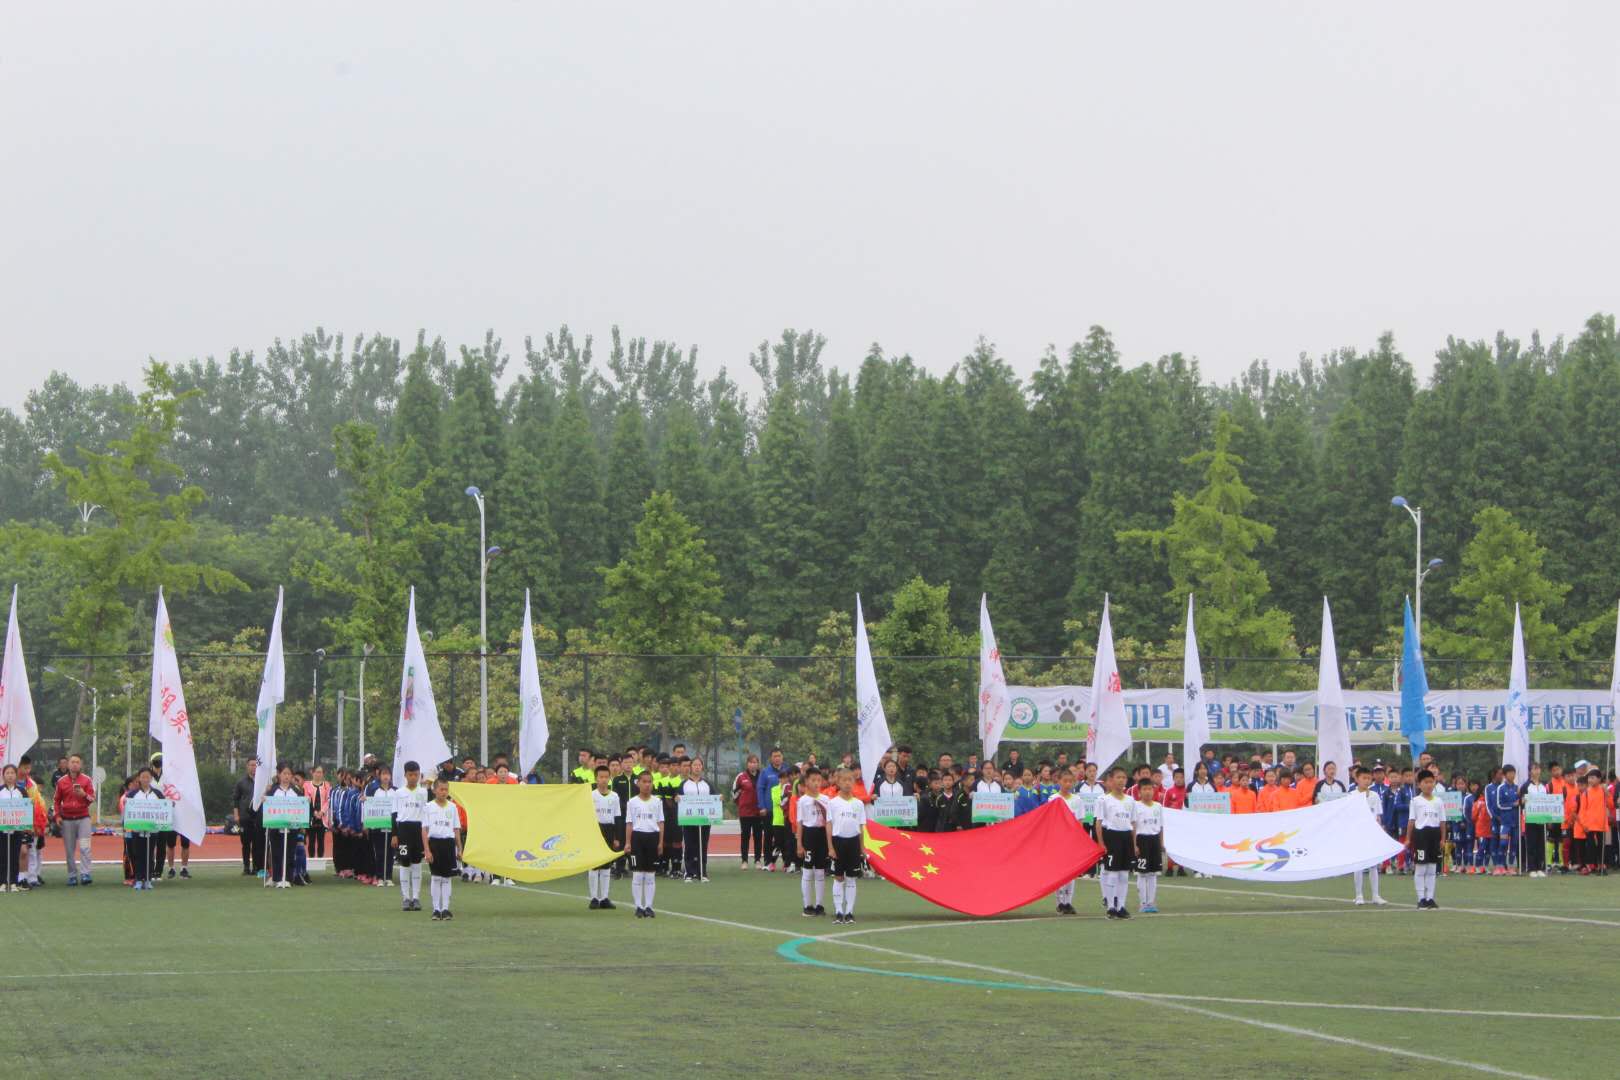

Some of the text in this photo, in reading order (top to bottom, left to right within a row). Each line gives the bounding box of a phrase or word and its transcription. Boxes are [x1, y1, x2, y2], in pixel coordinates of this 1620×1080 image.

[1124, 704, 1170, 728] 019
[1205, 703, 1295, 730] 省长杯”
[1107, 855, 1113, 867] 7
[1137, 858, 1147, 870] 22
